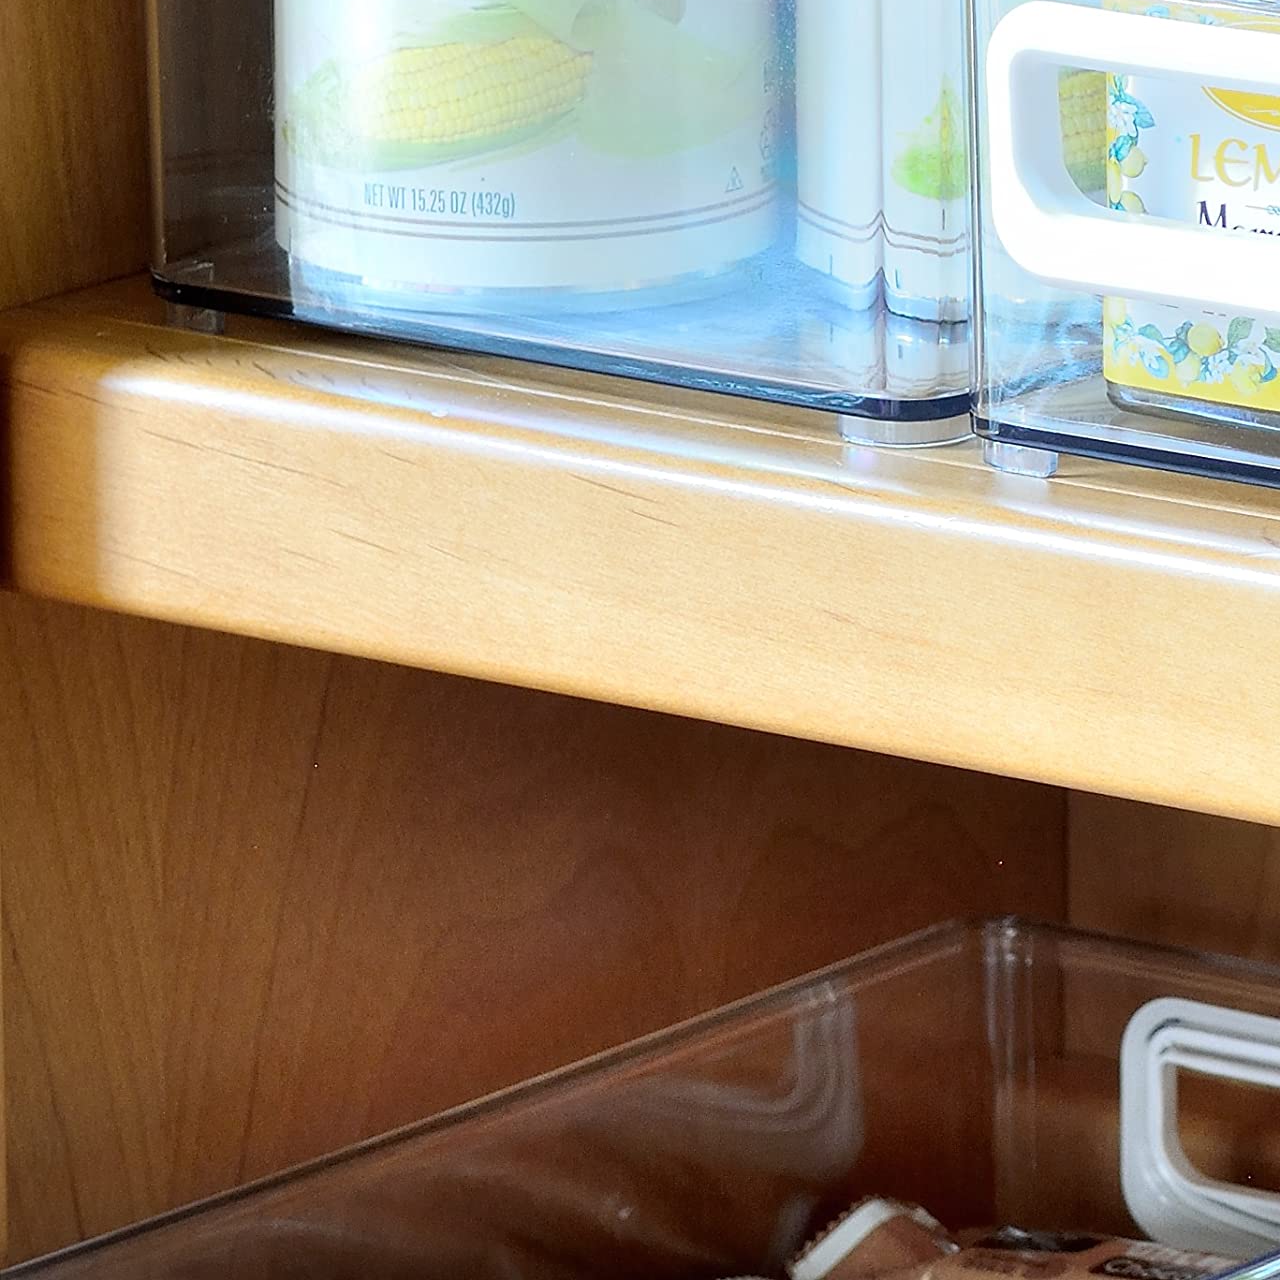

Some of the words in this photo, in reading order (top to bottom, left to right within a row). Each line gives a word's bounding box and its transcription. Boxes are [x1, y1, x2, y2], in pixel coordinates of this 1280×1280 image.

[364, 182, 384, 207] NET
[388, 186, 406, 209] WT
[411, 188, 445, 213] 15.25
[451, 191, 467, 214] OZ
[472, 191, 515, 218] (432g)
